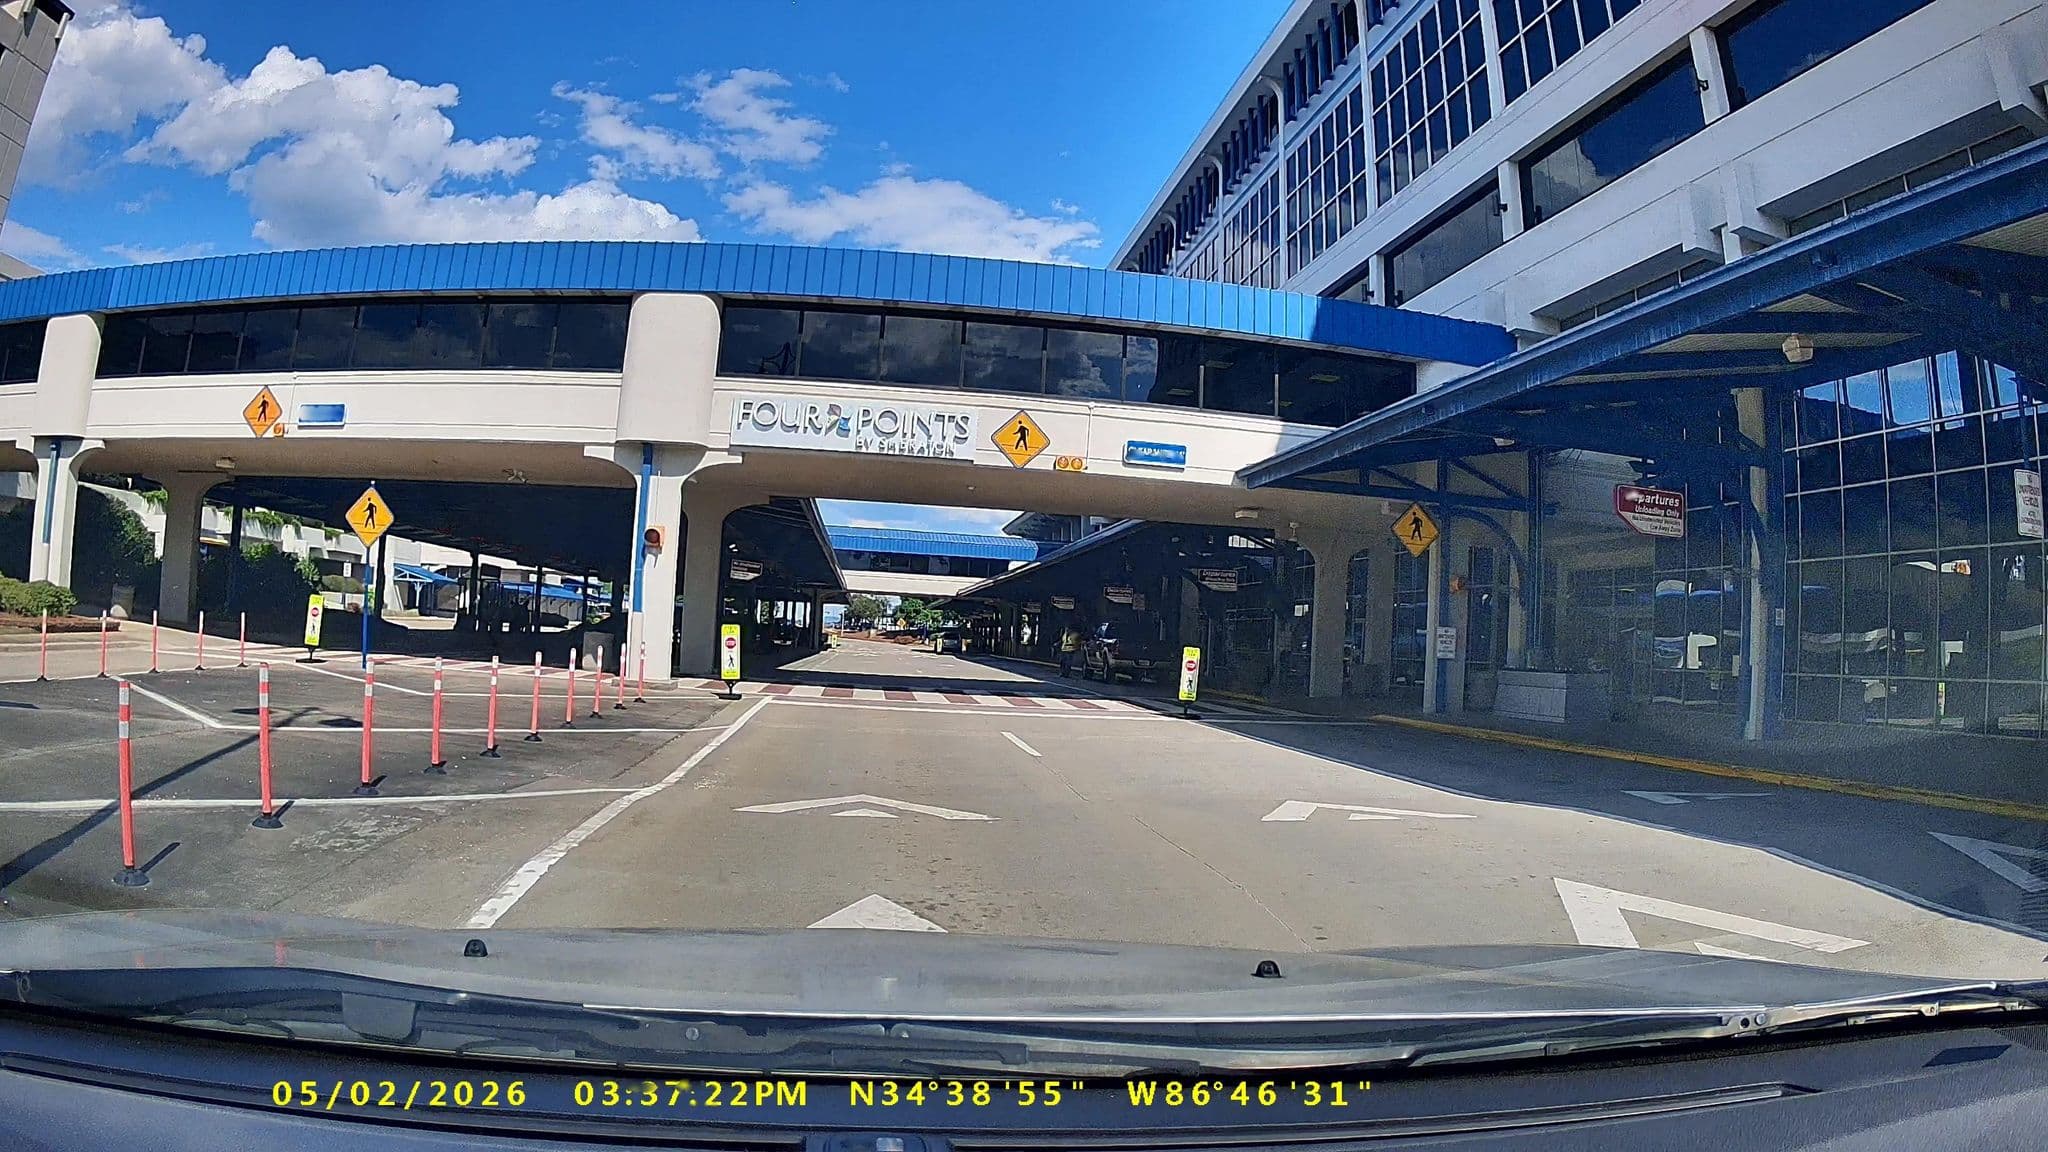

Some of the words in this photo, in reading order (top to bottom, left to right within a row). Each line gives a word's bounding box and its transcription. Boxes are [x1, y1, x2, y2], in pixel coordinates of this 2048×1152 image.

[737, 400, 823, 433] FOUR
[857, 406, 971, 443] POINTS
[856, 435, 874, 450] BY
[879, 436, 956, 457] SHERATON
[1626, 490, 1680, 507] partures
